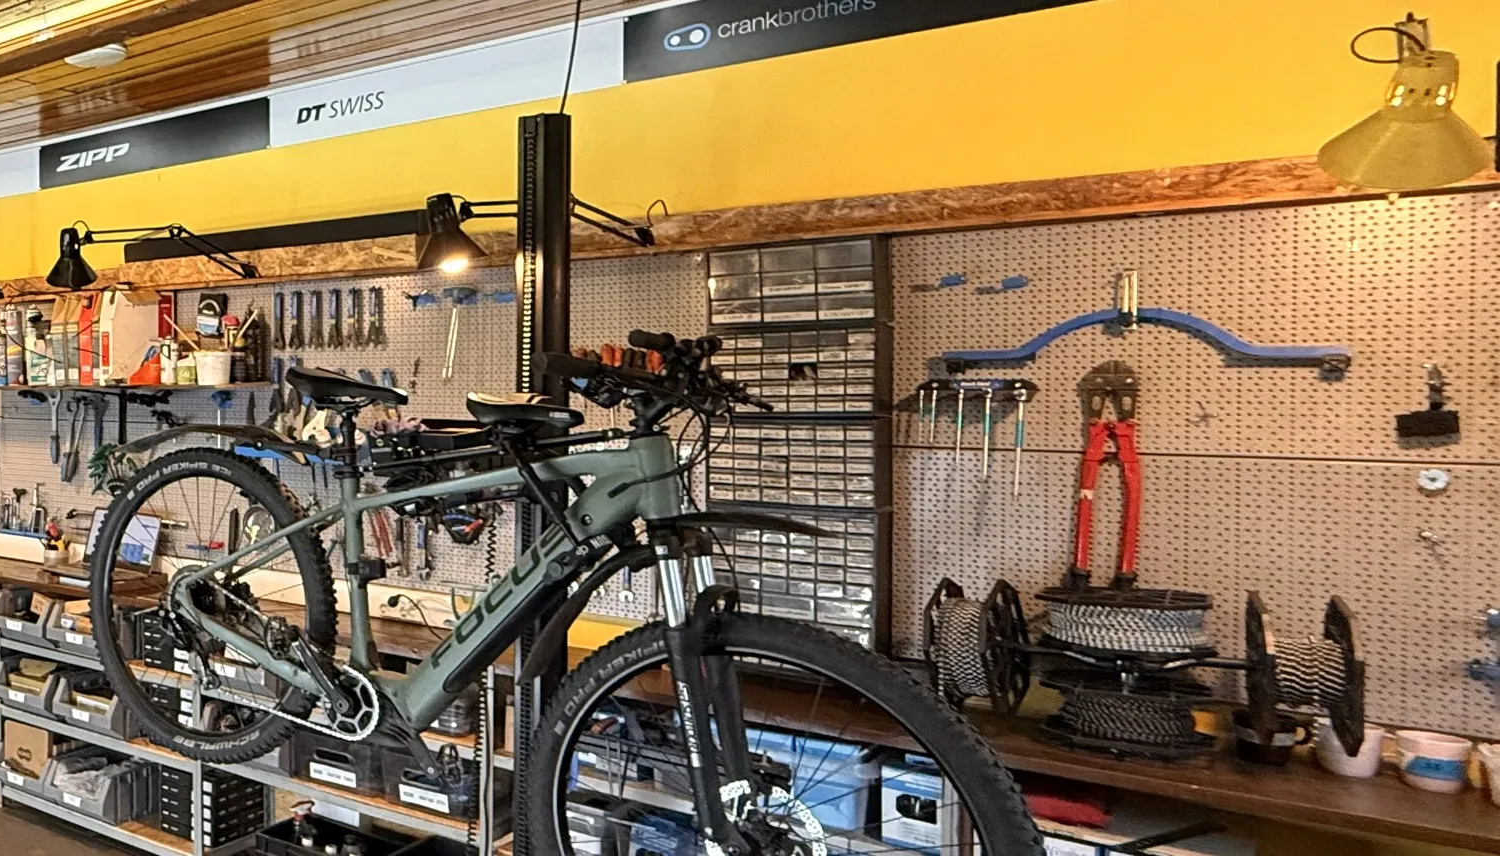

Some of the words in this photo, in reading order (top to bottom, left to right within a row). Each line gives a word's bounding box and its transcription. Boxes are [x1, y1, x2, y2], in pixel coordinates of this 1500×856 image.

[717, 0, 877, 39] crankbrothers
[296, 103, 327, 124] DT
[328, 91, 385, 119] SWISS
[56, 142, 130, 172] ZIPP
[136, 470, 161, 491] PRO
[430, 522, 570, 670] FOCUS
[172, 730, 260, 751] SCHWALBE
